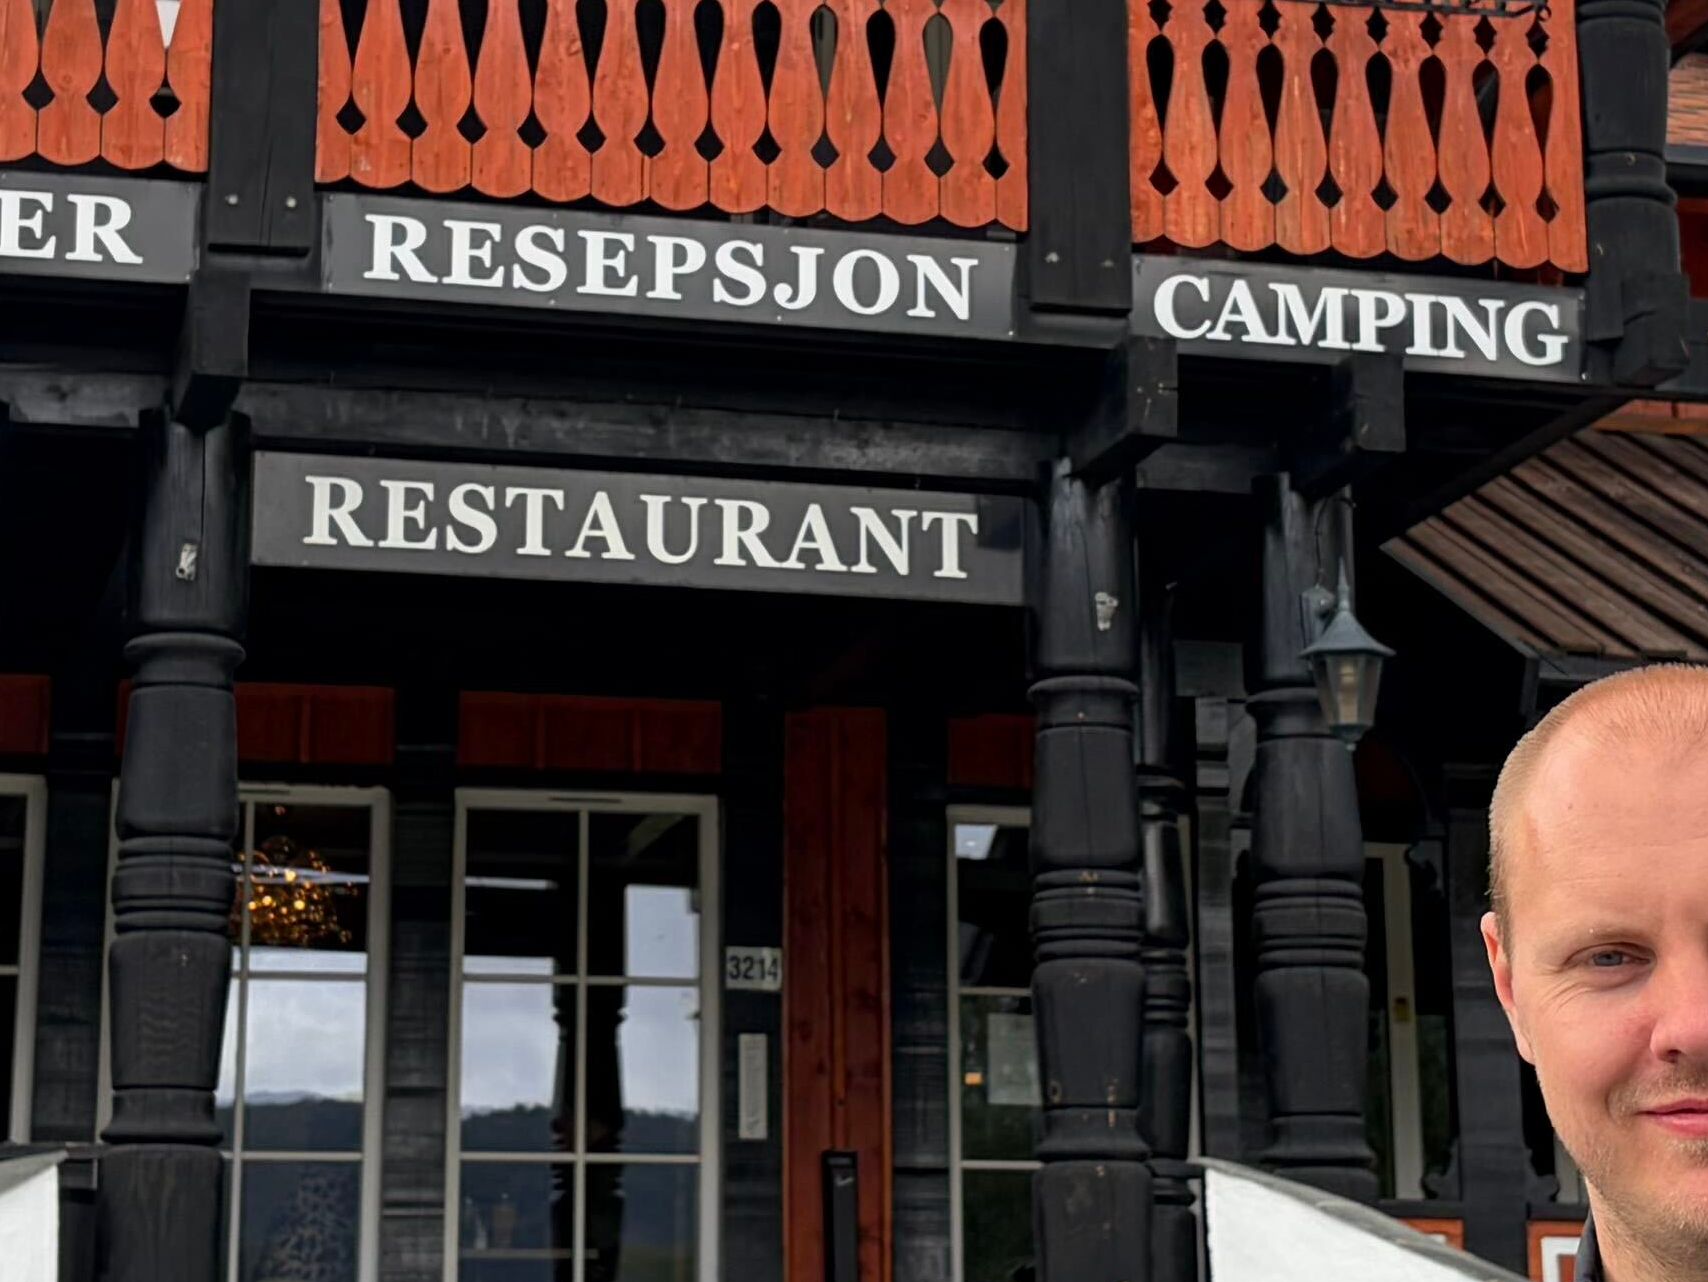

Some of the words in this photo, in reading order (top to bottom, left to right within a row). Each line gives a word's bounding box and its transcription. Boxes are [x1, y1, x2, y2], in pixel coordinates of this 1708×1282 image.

[0, 189, 144, 265] ER
[362, 213, 979, 321] RESEPSJON
[1153, 274, 1569, 366] CAMPING
[302, 475, 978, 579] RESTAURANT
[729, 955, 778, 981] 3214
